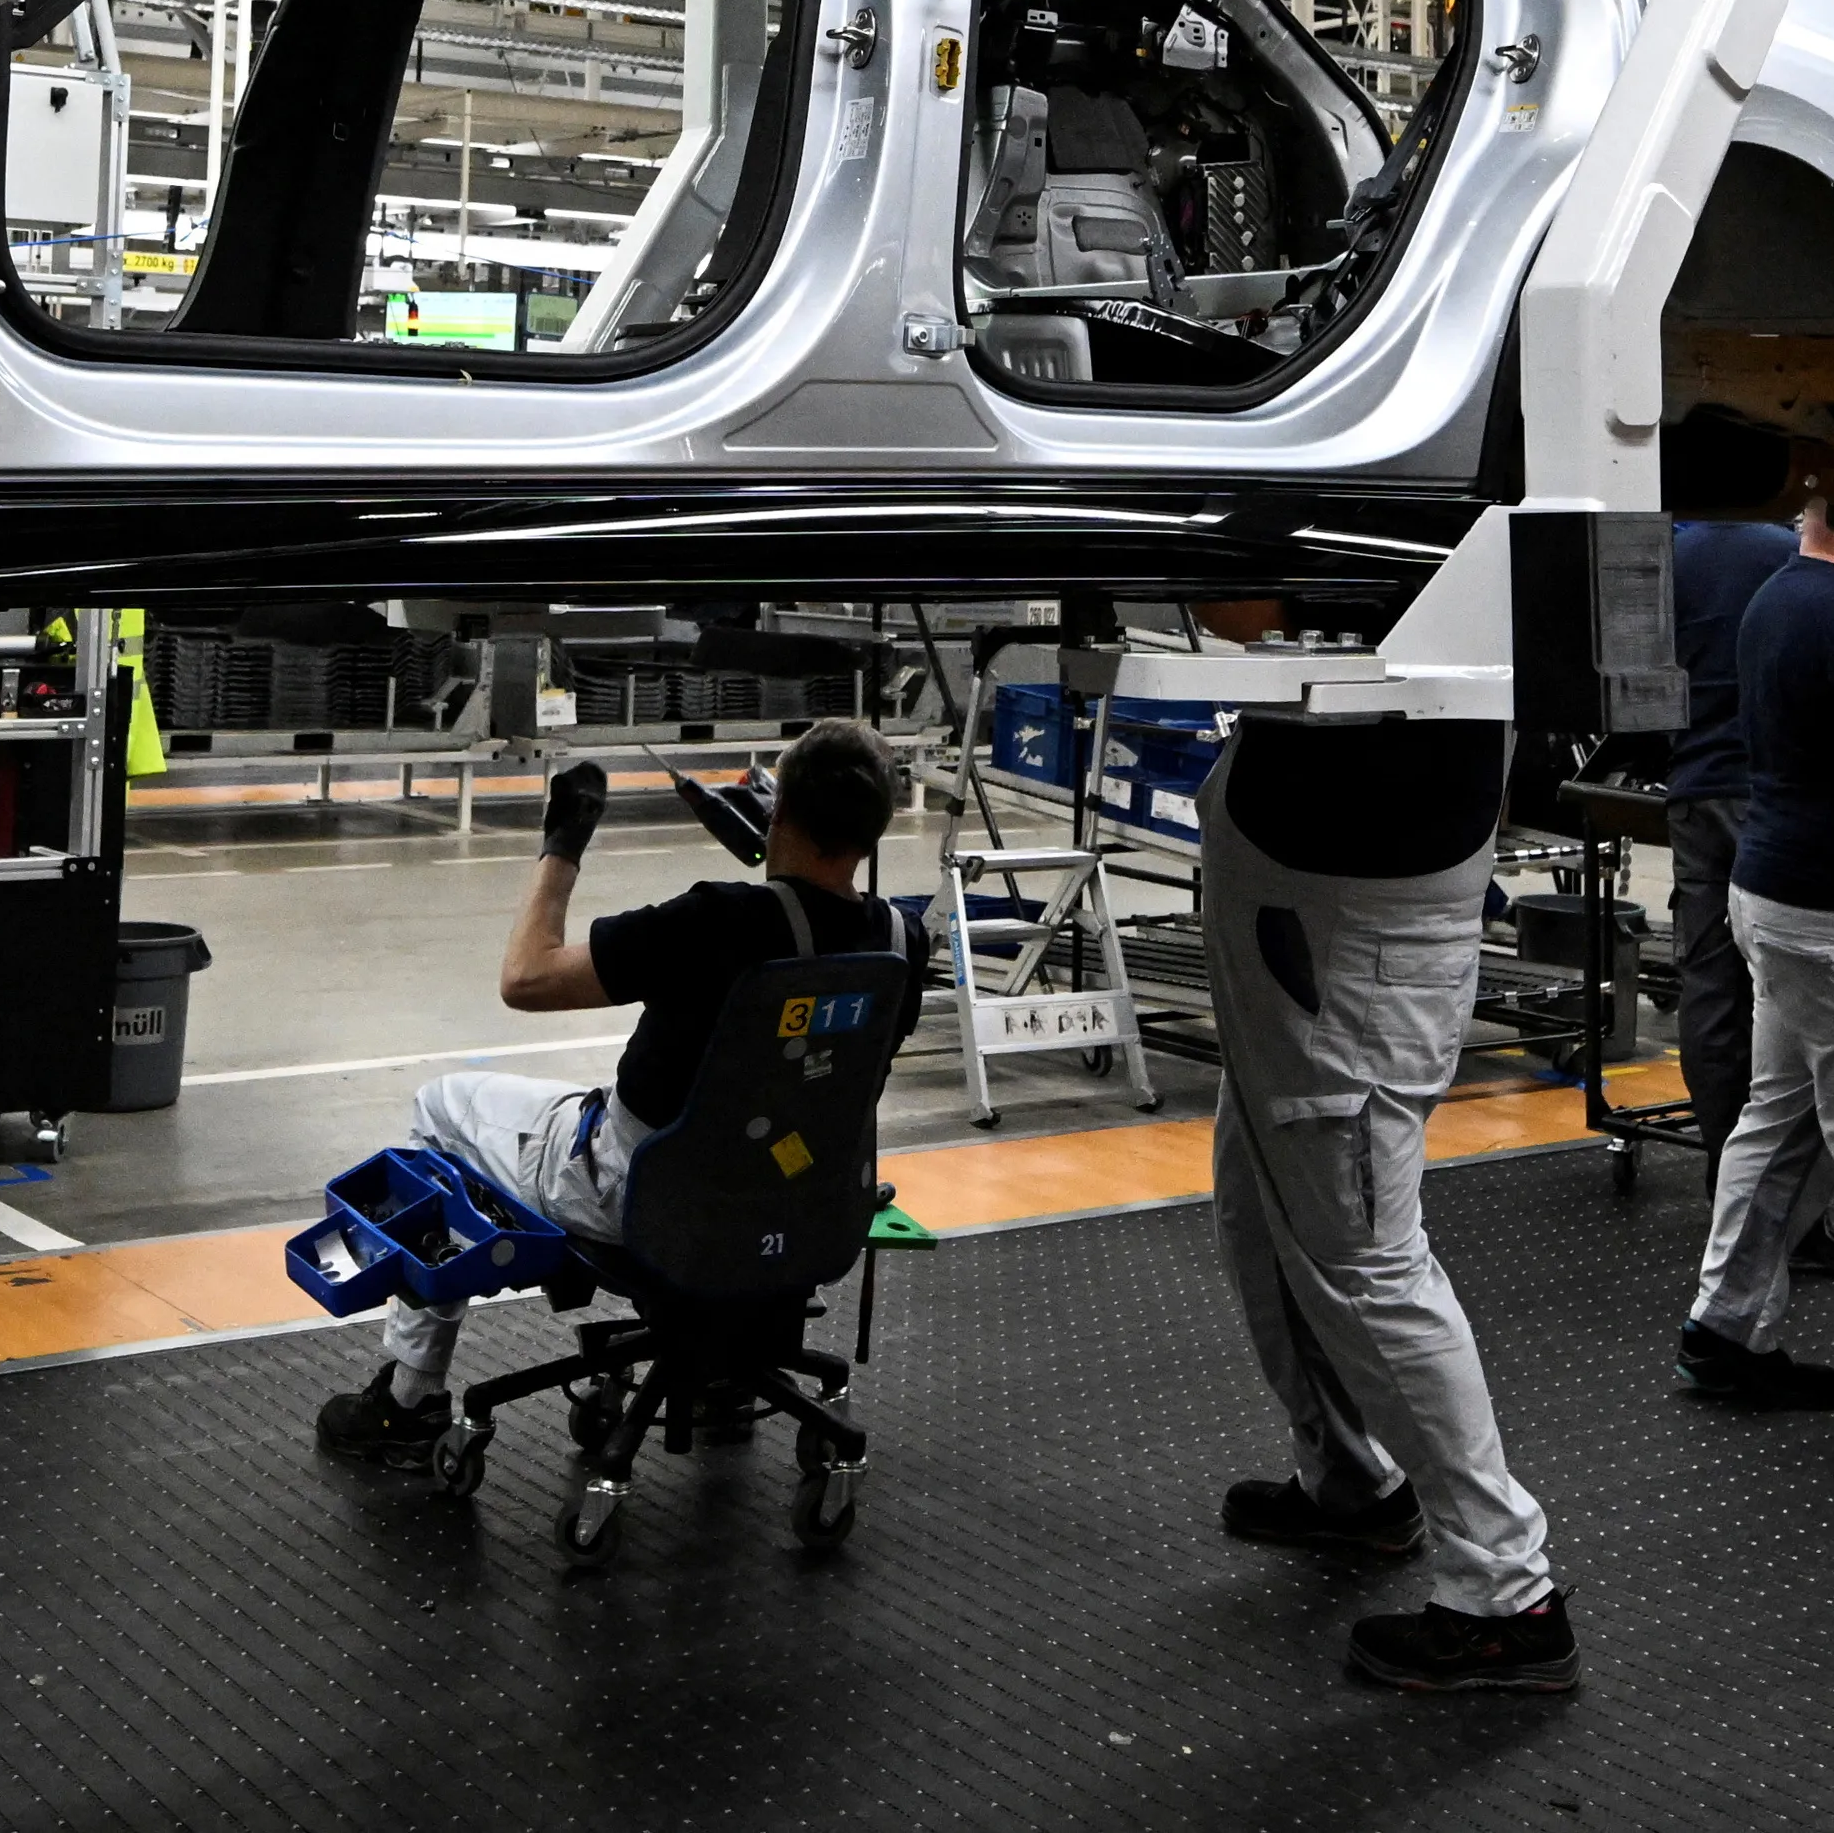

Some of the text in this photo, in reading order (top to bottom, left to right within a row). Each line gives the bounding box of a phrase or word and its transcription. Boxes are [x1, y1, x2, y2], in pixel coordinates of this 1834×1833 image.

[134, 255, 159, 268] 2700
[161, 258, 175, 272] kg
[760, 1232, 785, 1257] 21
